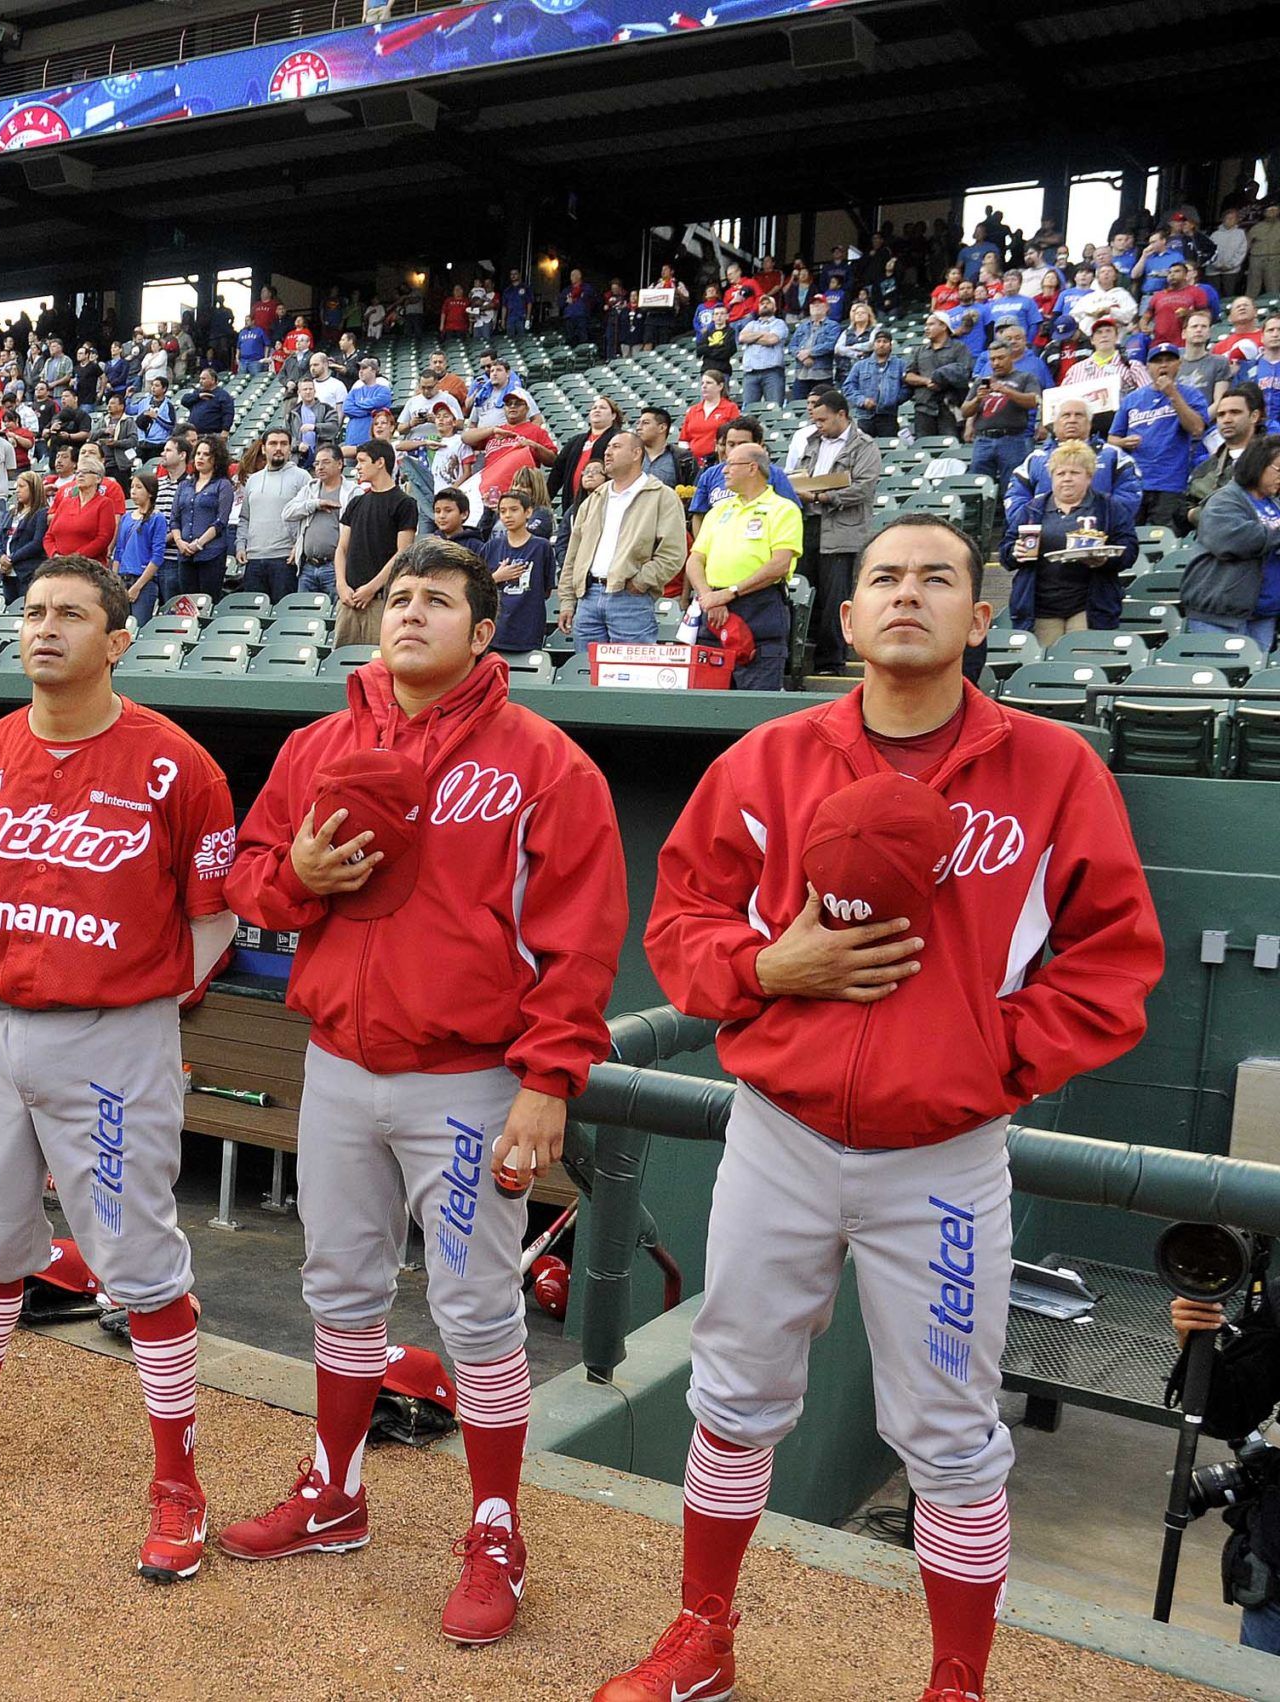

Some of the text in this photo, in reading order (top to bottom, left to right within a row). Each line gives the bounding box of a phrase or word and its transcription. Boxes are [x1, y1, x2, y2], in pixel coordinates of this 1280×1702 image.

[276, 54, 320, 77] TEXAS
[600, 645, 688, 657] ONE BEER LIMIT
[146, 756, 179, 800] 3
[89, 1081, 124, 1194] telcel
[439, 1116, 484, 1236] telcel
[928, 1195, 975, 1335] telcel
